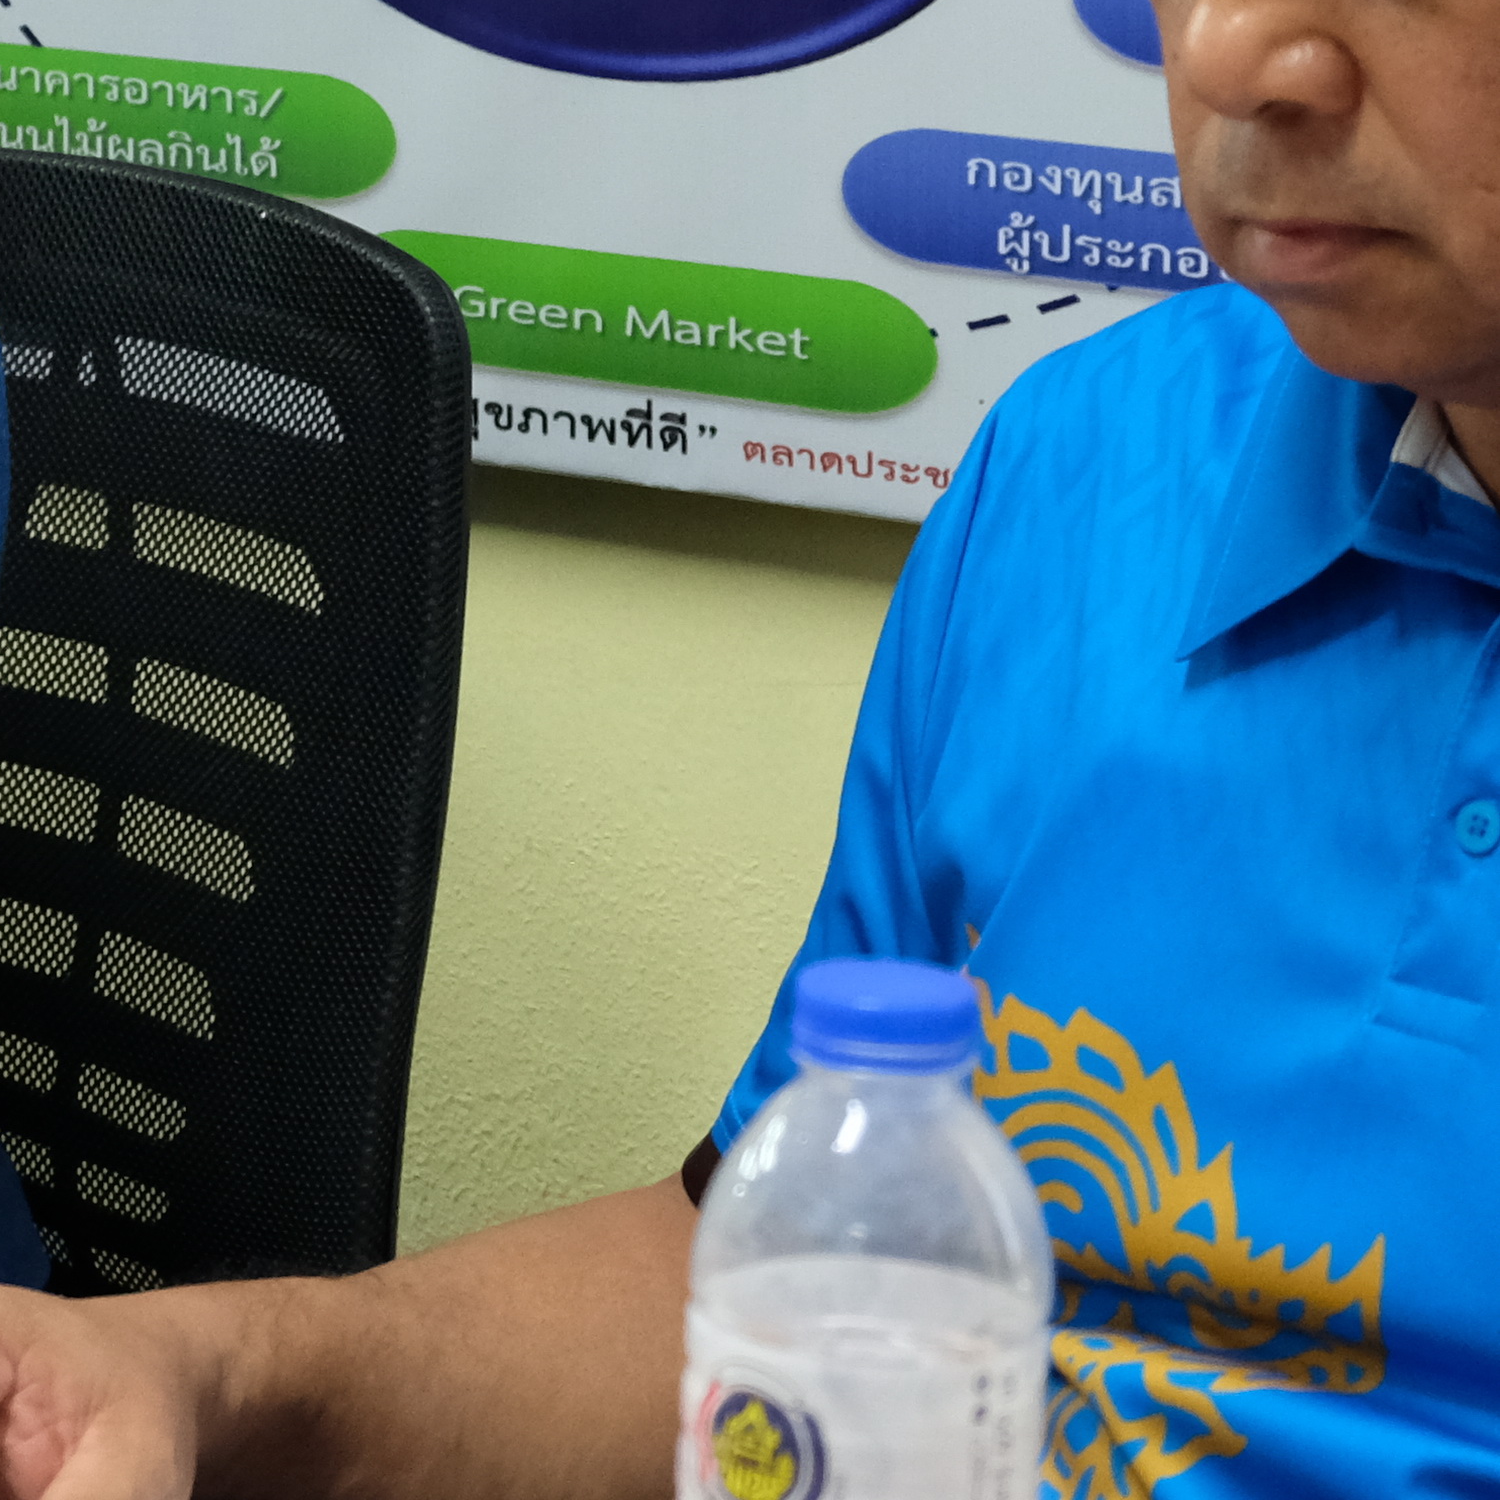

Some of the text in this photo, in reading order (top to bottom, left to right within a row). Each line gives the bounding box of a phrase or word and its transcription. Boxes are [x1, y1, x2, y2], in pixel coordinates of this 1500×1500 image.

[997, 212, 1212, 279] ผู้ประกอ
[453, 285, 811, 361] Green Market
